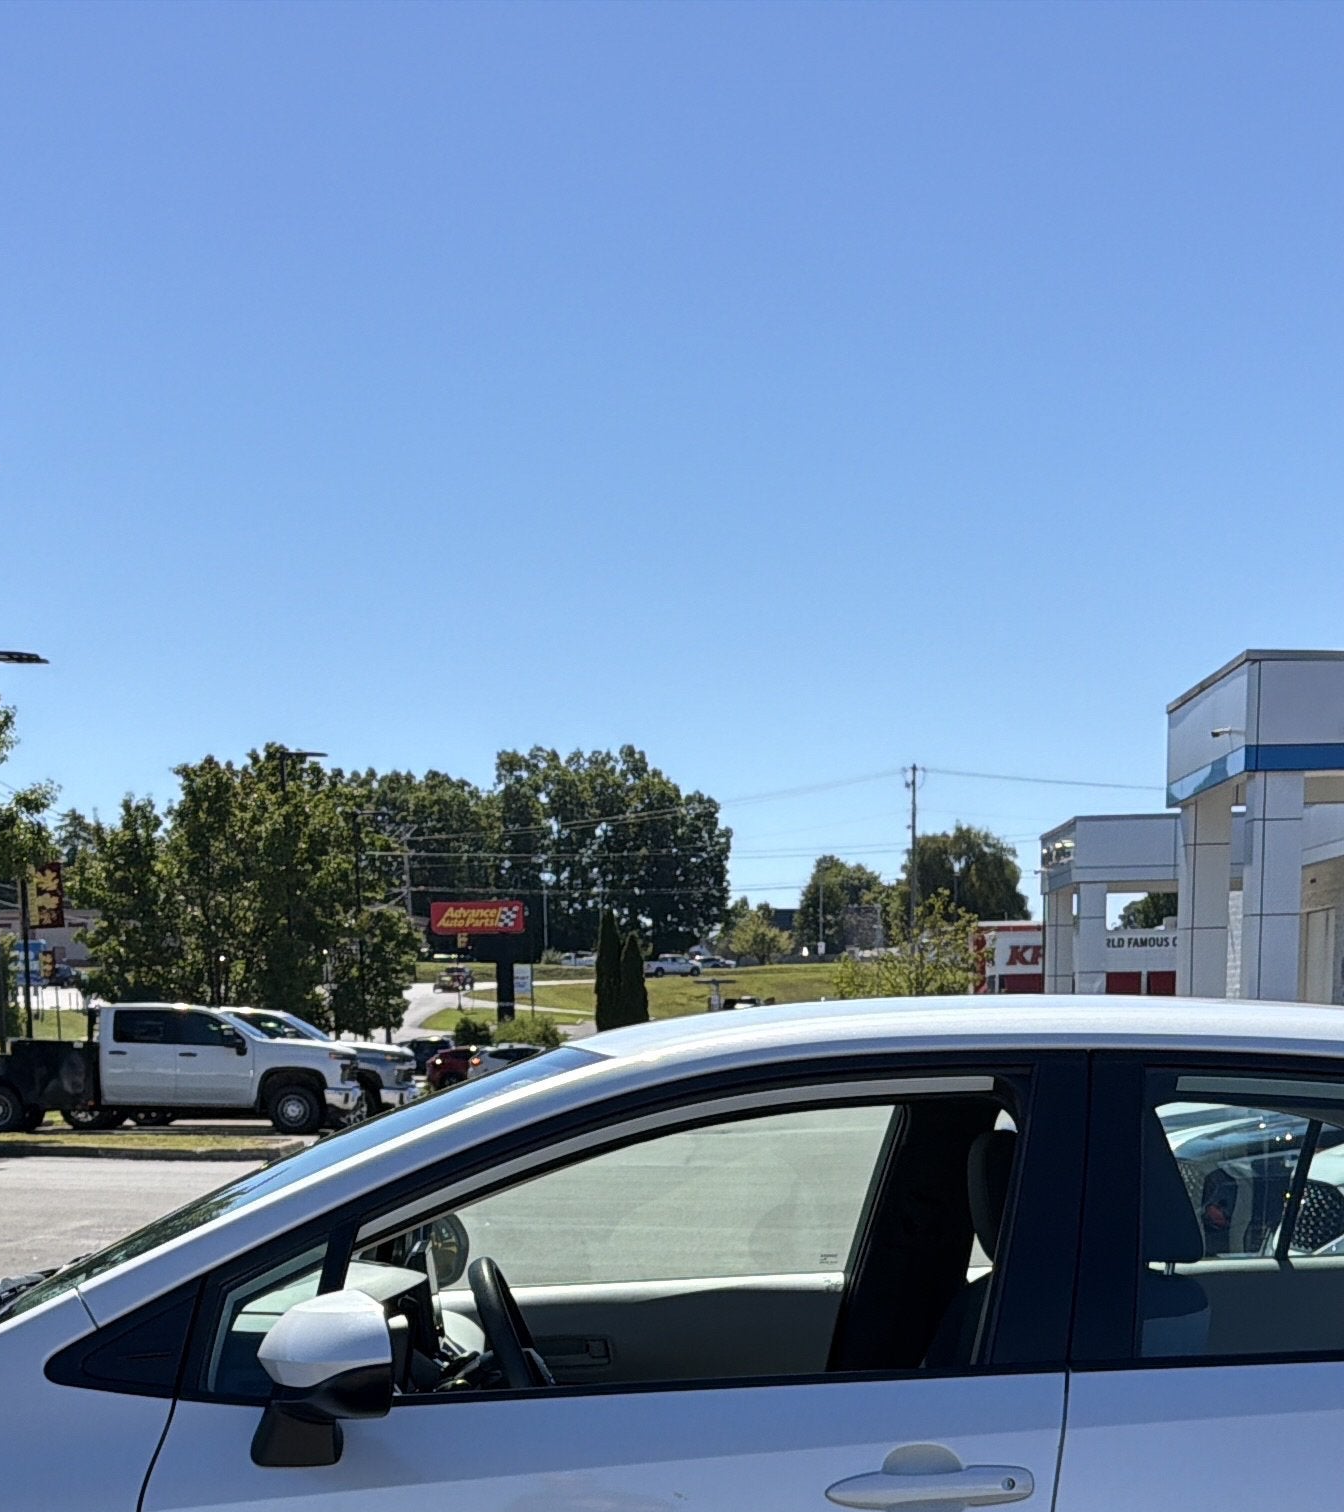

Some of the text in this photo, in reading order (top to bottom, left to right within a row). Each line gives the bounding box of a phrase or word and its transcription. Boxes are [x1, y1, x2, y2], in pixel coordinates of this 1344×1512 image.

[444, 907, 497, 918] Advance
[437, 917, 497, 928] Auto Parts
[1106, 938, 1125, 948] RLD
[1127, 937, 1169, 948] FAMOUS
[1006, 945, 1042, 965] KF
